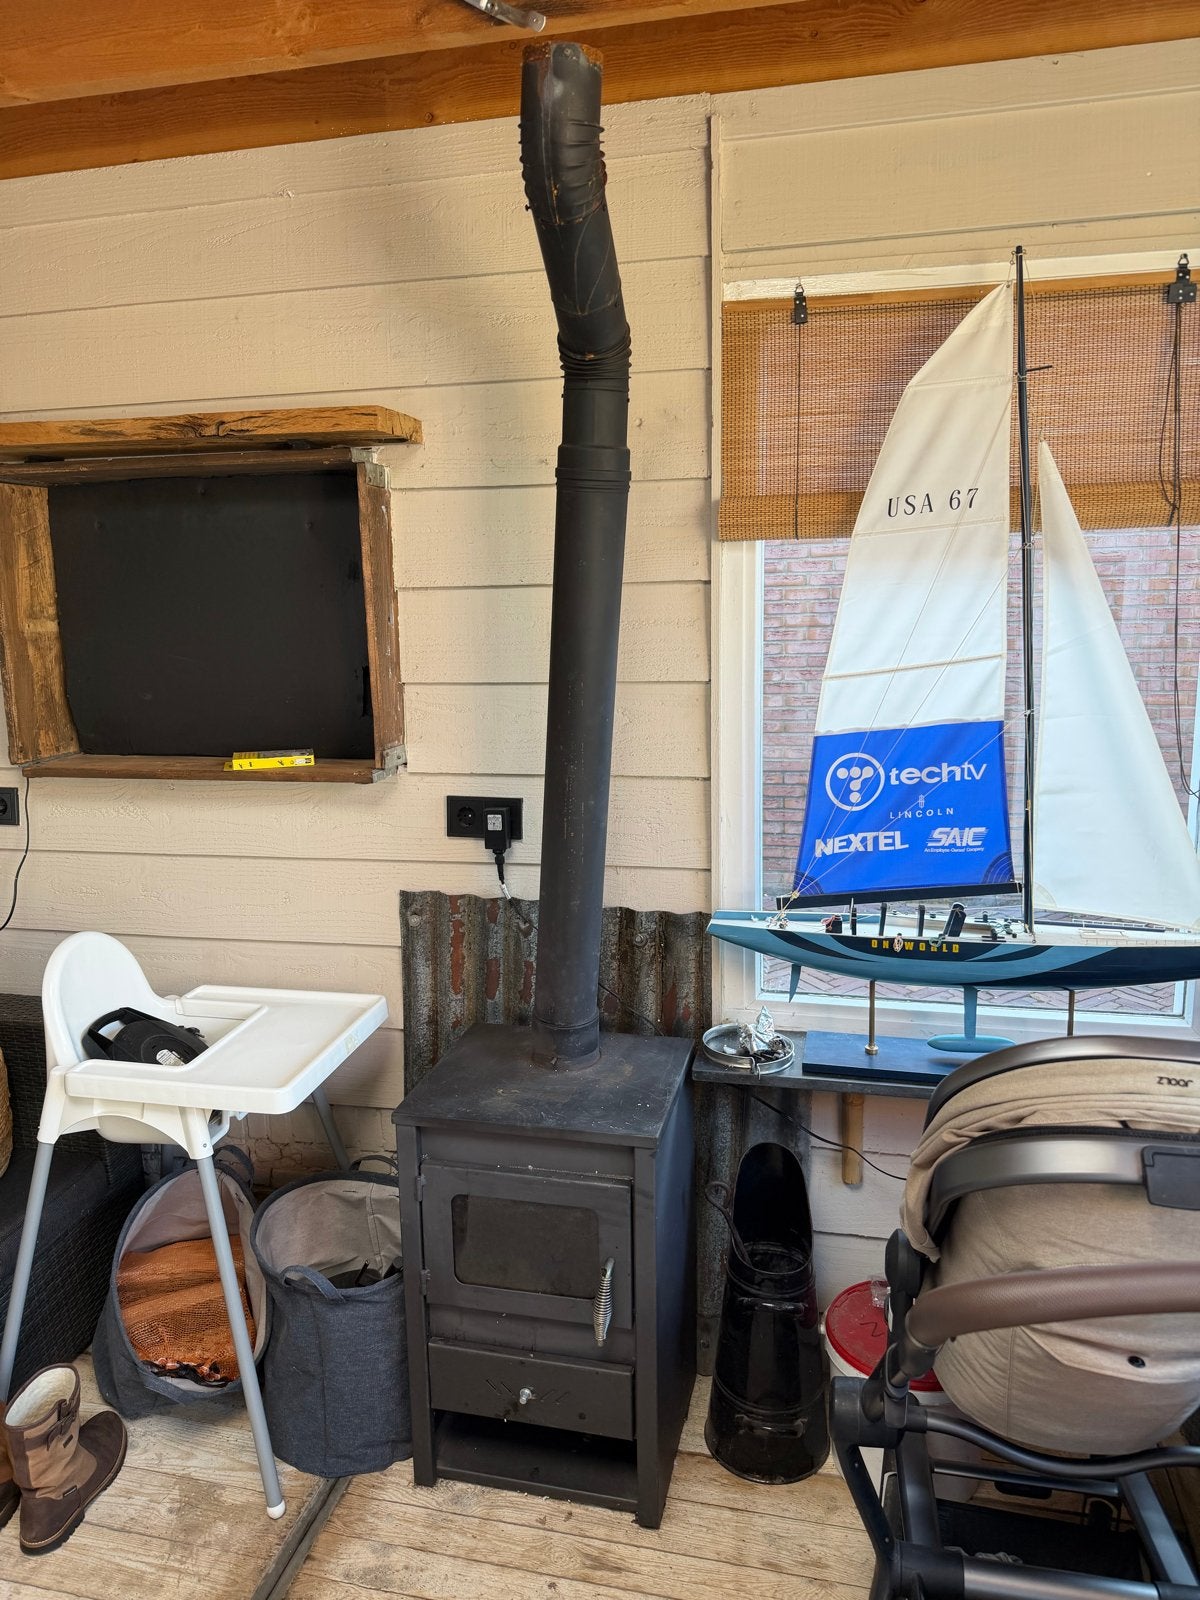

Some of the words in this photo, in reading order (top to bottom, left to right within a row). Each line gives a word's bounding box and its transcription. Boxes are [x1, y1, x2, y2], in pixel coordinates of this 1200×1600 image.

[887, 493, 934, 518] USA
[949, 487, 979, 511] 67
[889, 761, 988, 785] techtv
[890, 807, 954, 819] LINCOLN
[814, 830, 909, 858] NEXTEL
[926, 826, 988, 847] SAIC
